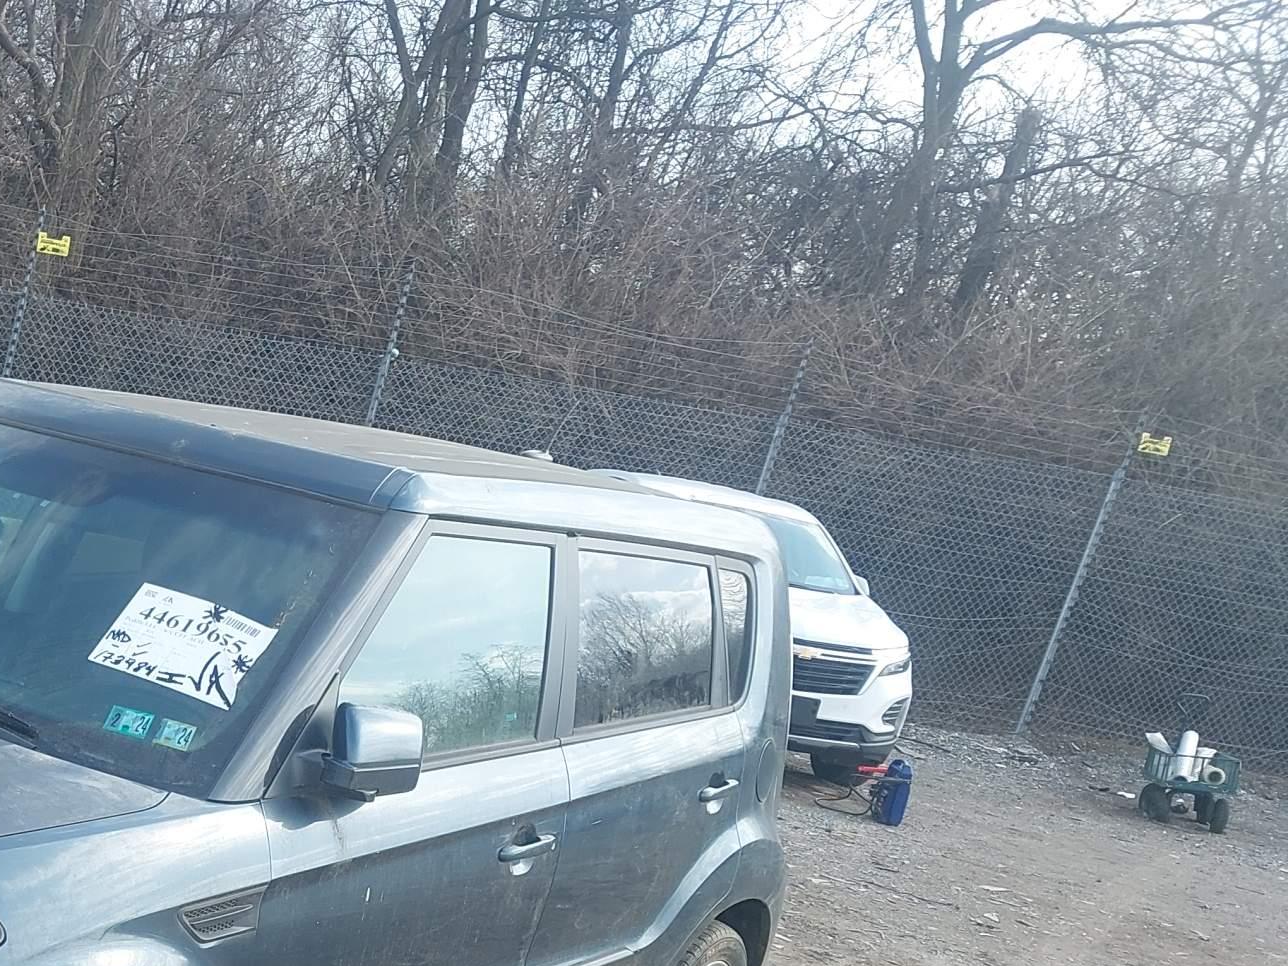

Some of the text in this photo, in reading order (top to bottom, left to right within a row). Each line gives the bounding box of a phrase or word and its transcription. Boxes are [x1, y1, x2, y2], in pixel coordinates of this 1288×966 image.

[139, 605, 248, 655] 44619655
[135, 716, 152, 735] 24
[176, 727, 194, 747] 24
